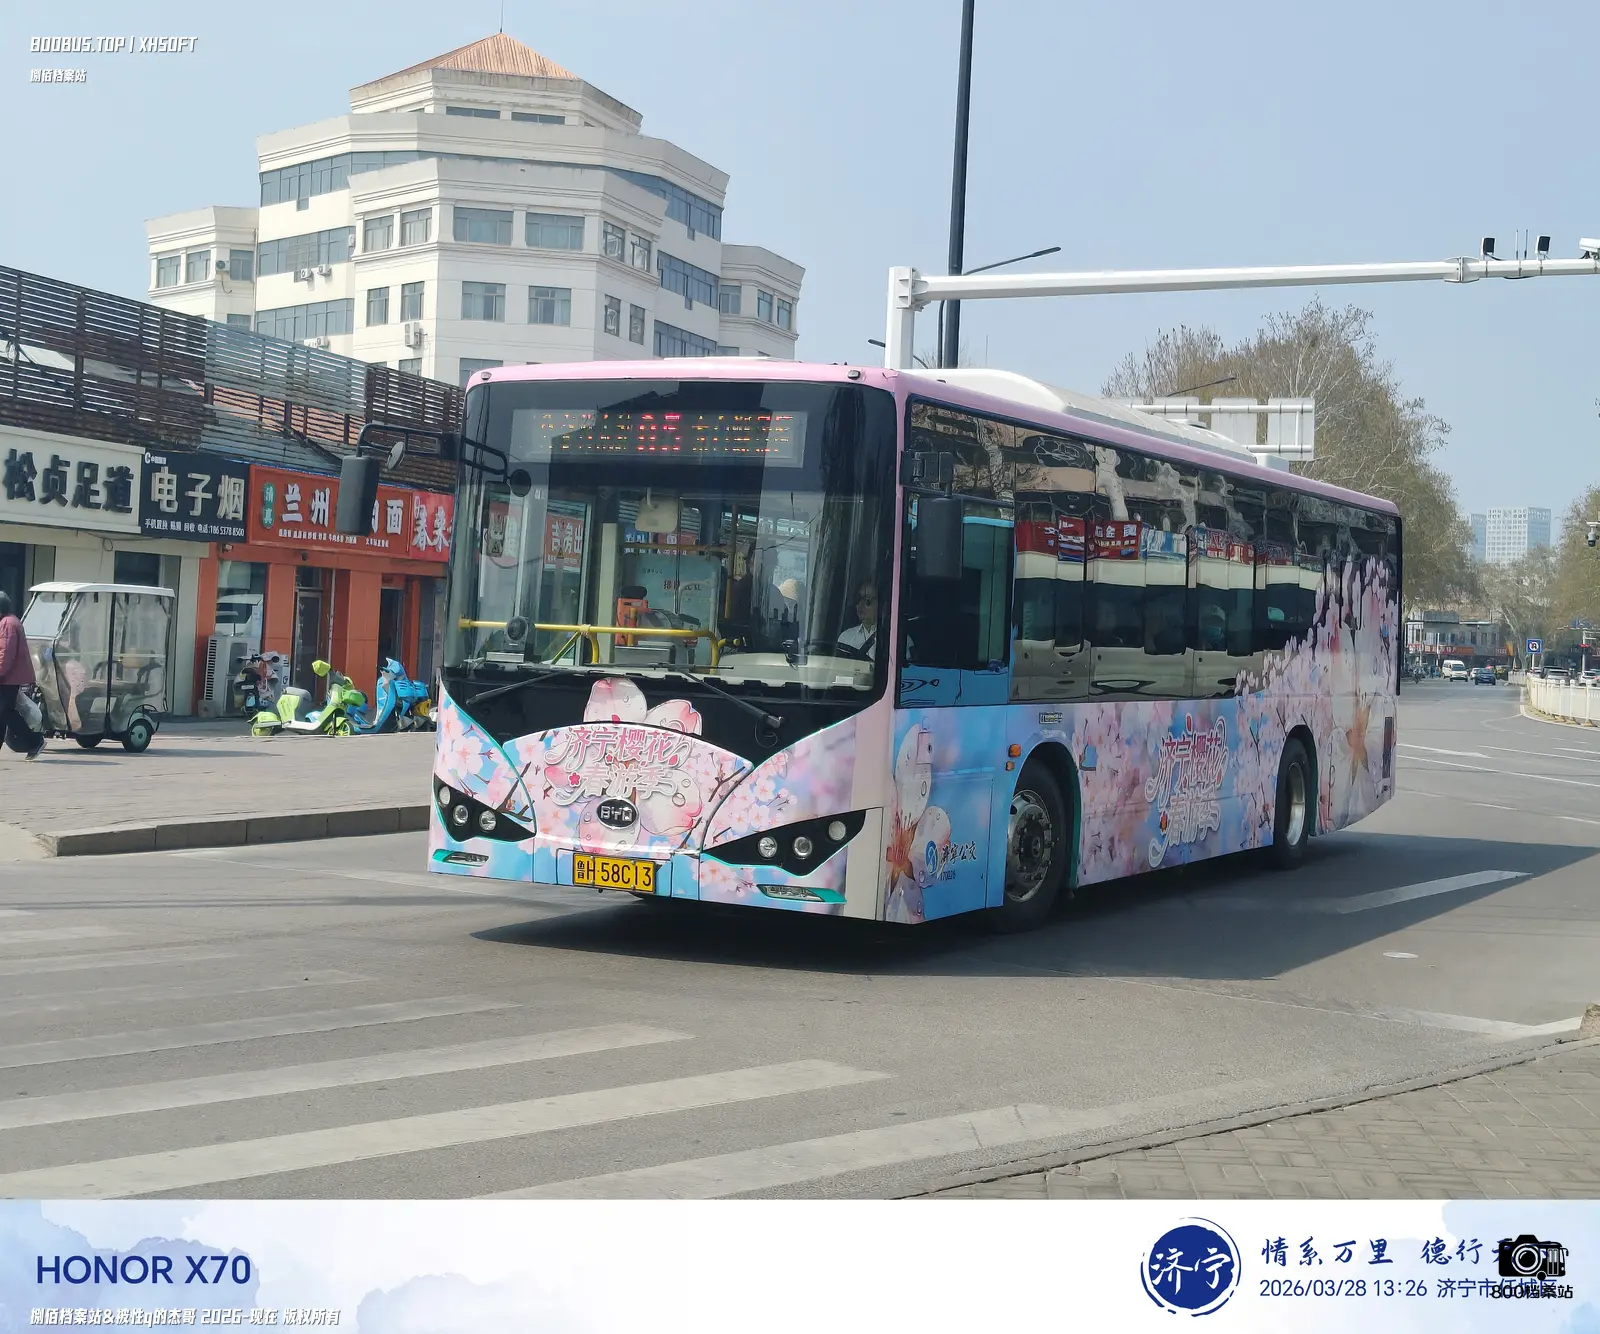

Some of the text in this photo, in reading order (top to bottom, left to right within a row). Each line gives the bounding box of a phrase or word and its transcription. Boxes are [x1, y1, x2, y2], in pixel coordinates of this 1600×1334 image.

[4, 448, 134, 514] 松贞足道
[152, 466, 244, 520] 电子烟
[282, 483, 404, 535] 兰州面
[546, 727, 692, 771] 济宁樱花
[1146, 722, 1228, 810] 济宁樱花
[552, 764, 678, 806] 春游季
[600, 805, 633, 822] BYD
[939, 841, 977, 867] 济宁公交
